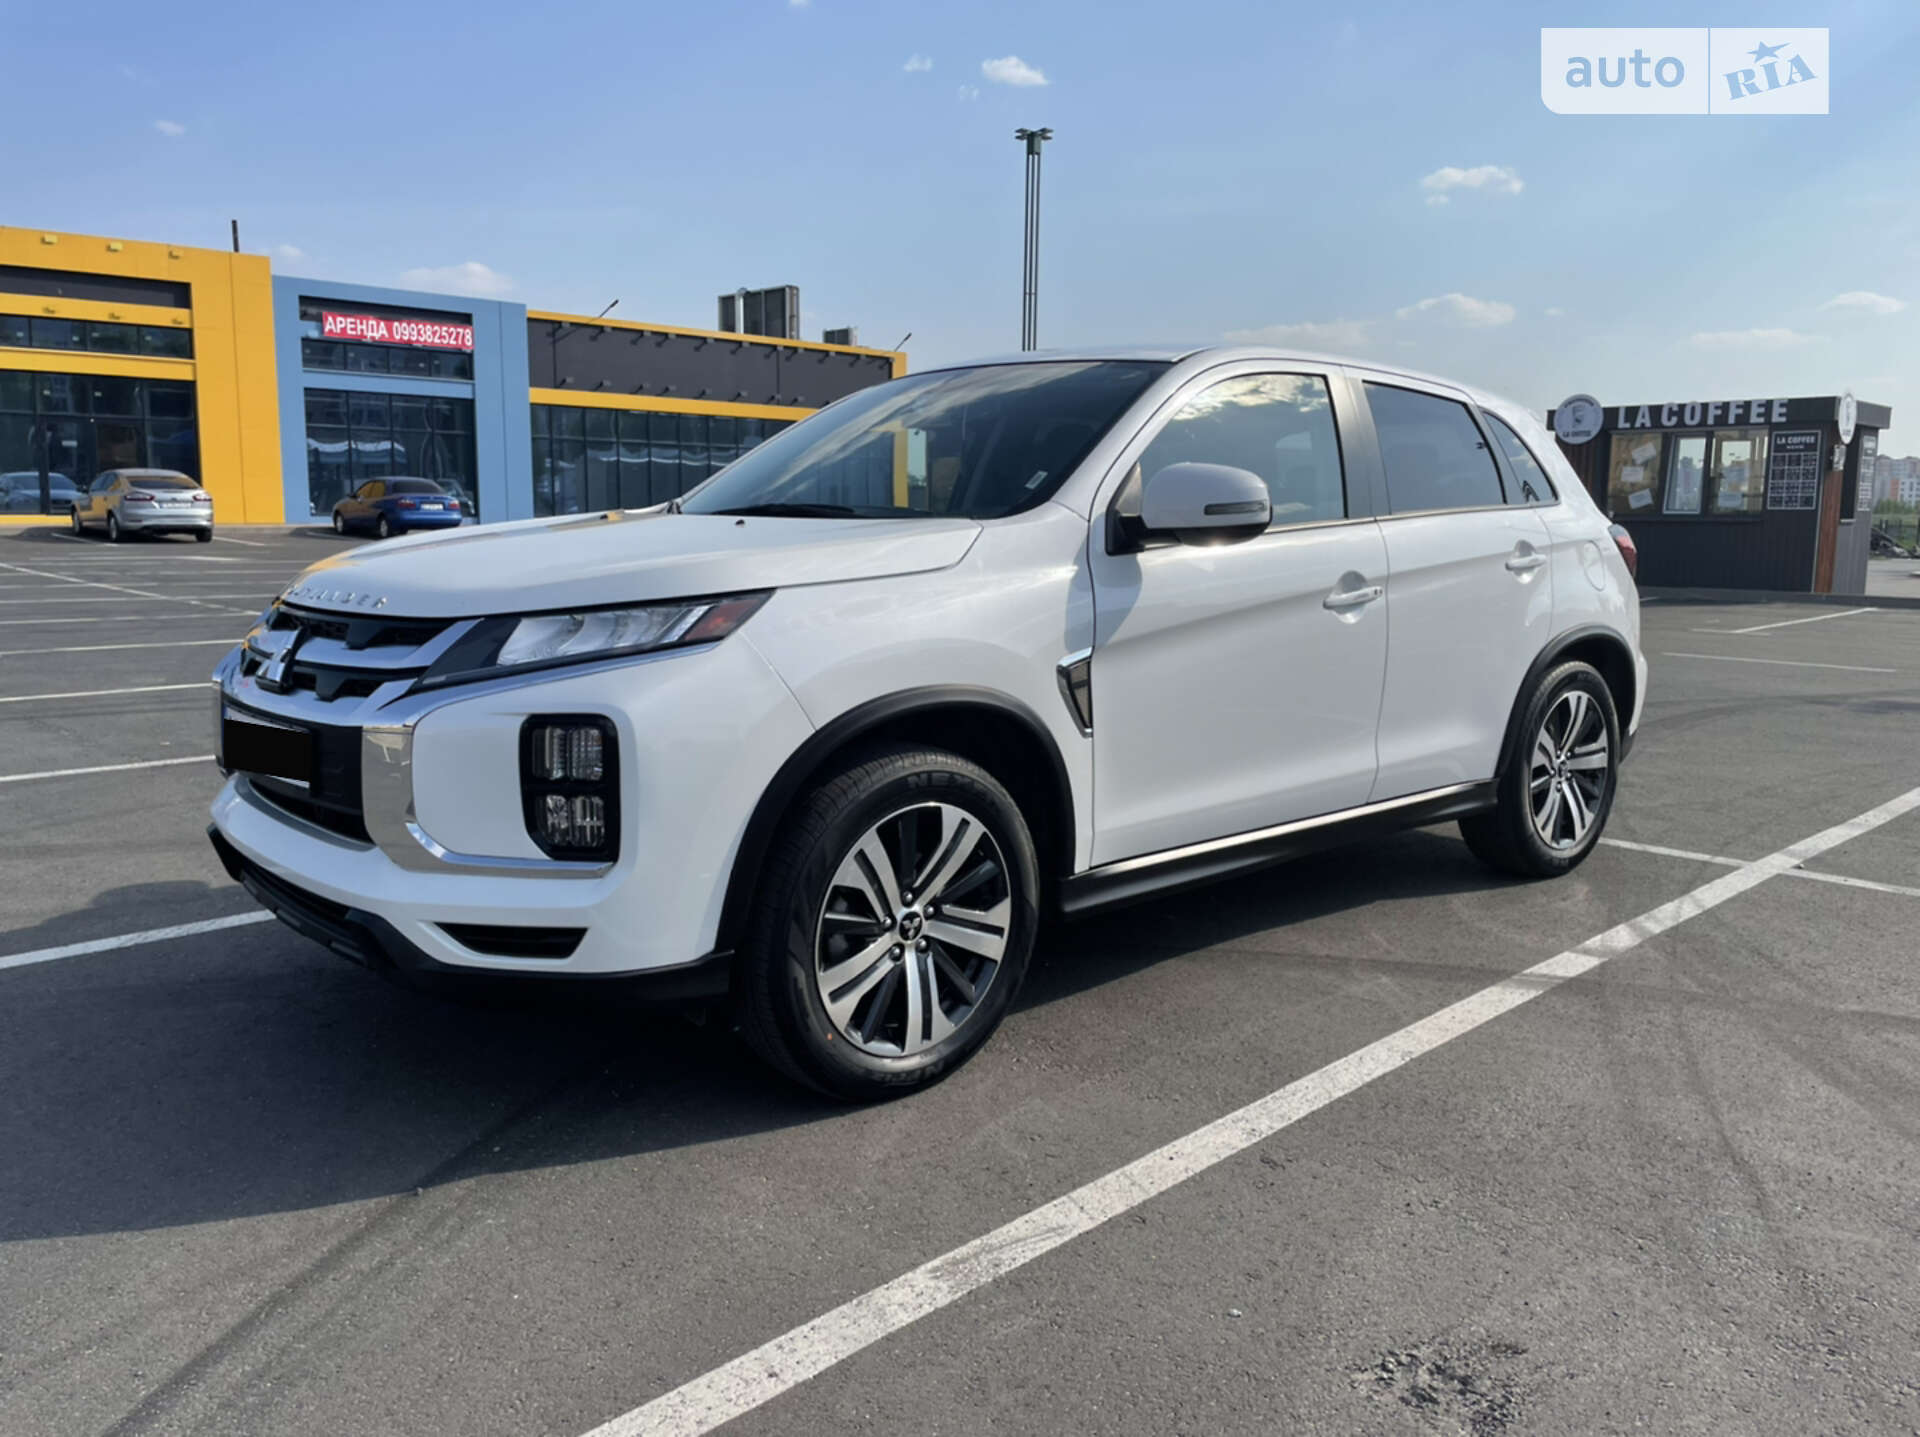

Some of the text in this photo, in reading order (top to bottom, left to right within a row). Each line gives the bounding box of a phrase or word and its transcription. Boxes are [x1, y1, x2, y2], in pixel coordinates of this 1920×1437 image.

[325, 316, 473, 347] АРЕНДА 0993825278
[1617, 400, 1789, 429] LA COFFEE
